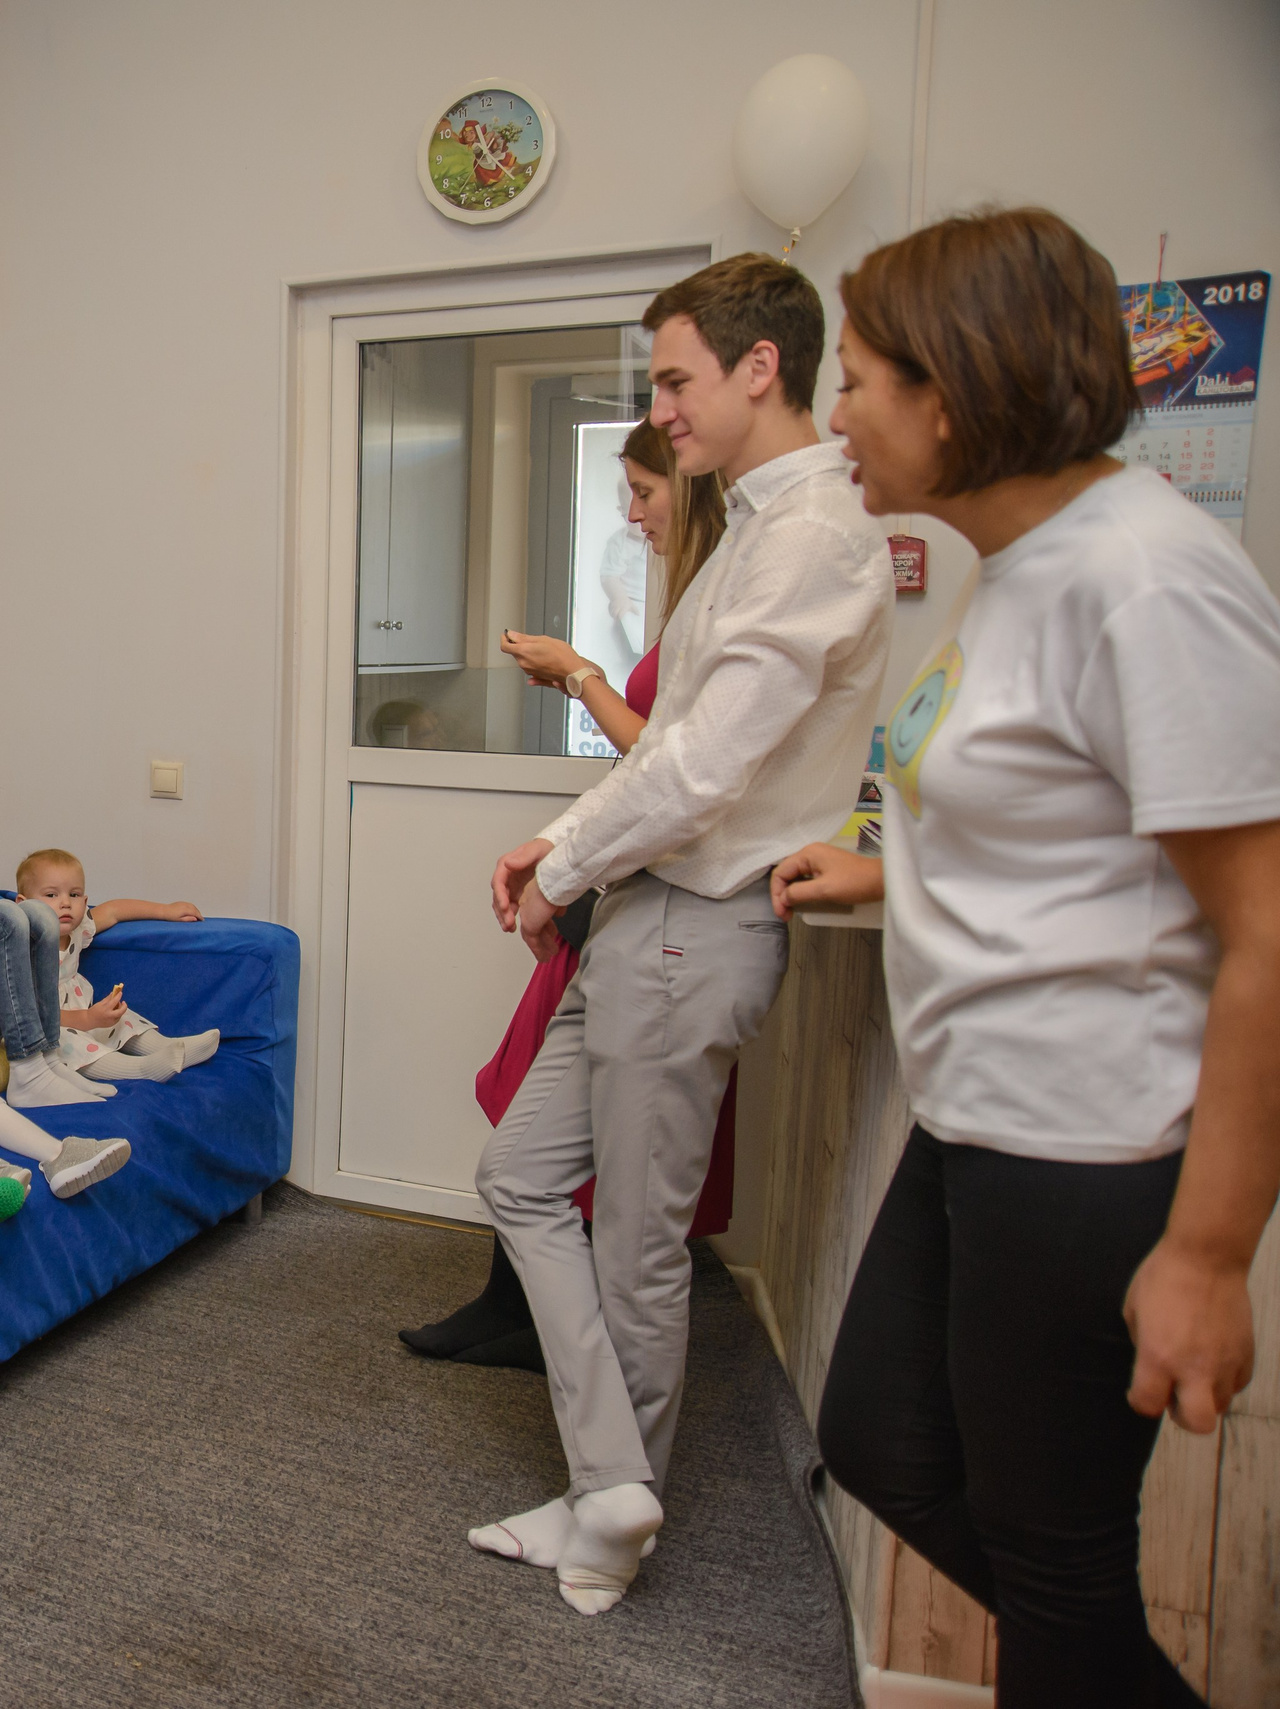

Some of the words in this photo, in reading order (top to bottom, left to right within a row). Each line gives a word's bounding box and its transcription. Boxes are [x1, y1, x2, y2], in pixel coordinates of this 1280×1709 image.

[481, 97, 493, 108] 12
[457, 108, 467, 118] 11
[525, 115, 532, 126] 2
[439, 128, 452, 139] 10
[532, 140, 539, 150] 3
[435, 155, 443, 165] 9
[525, 165, 532, 176] 4
[442, 178, 449, 189] 8
[508, 187, 515, 198] 5
[460, 193, 468, 204] 7
[484, 197, 491, 208] 6
[1202, 282, 1264, 306] 2018
[1206, 428, 1214, 436] 2
[1180, 452, 1193, 460] 15
[1202, 451, 1215, 459] 16
[1178, 463, 1192, 471] 22
[1200, 462, 1214, 470] 23
